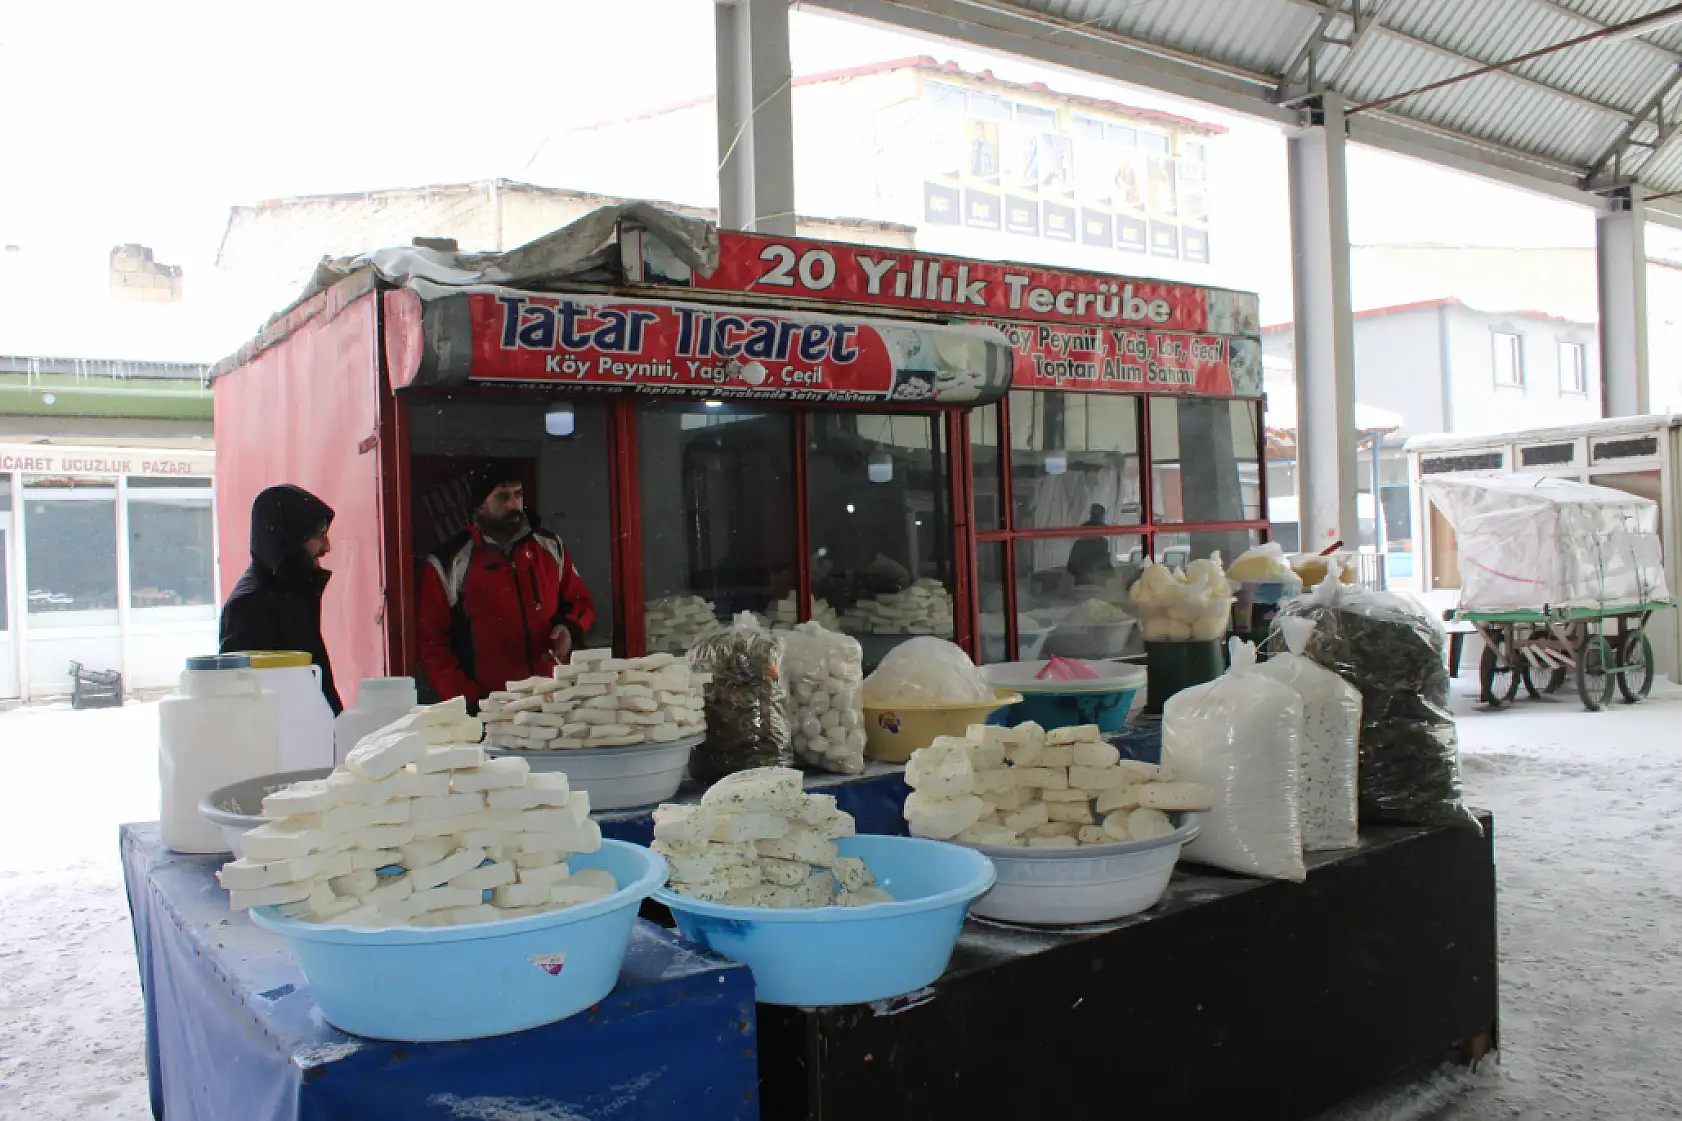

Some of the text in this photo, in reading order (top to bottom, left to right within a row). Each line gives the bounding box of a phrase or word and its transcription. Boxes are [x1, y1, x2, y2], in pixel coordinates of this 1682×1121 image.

[759, 244, 1172, 323] 20 Yıllık Tecrübe
[496, 296, 859, 365] Tatar Ticaret
[1111, 330, 1155, 363] Yağ,
[1156, 334, 1188, 364] Lor,
[545, 354, 592, 380] Köy
[597, 356, 679, 381] Peyniri,
[686, 360, 730, 384] Yağ,
[781, 364, 823, 387] Çeçil
[1031, 352, 1099, 386] Toptan
[1101, 356, 1142, 383] Alım
